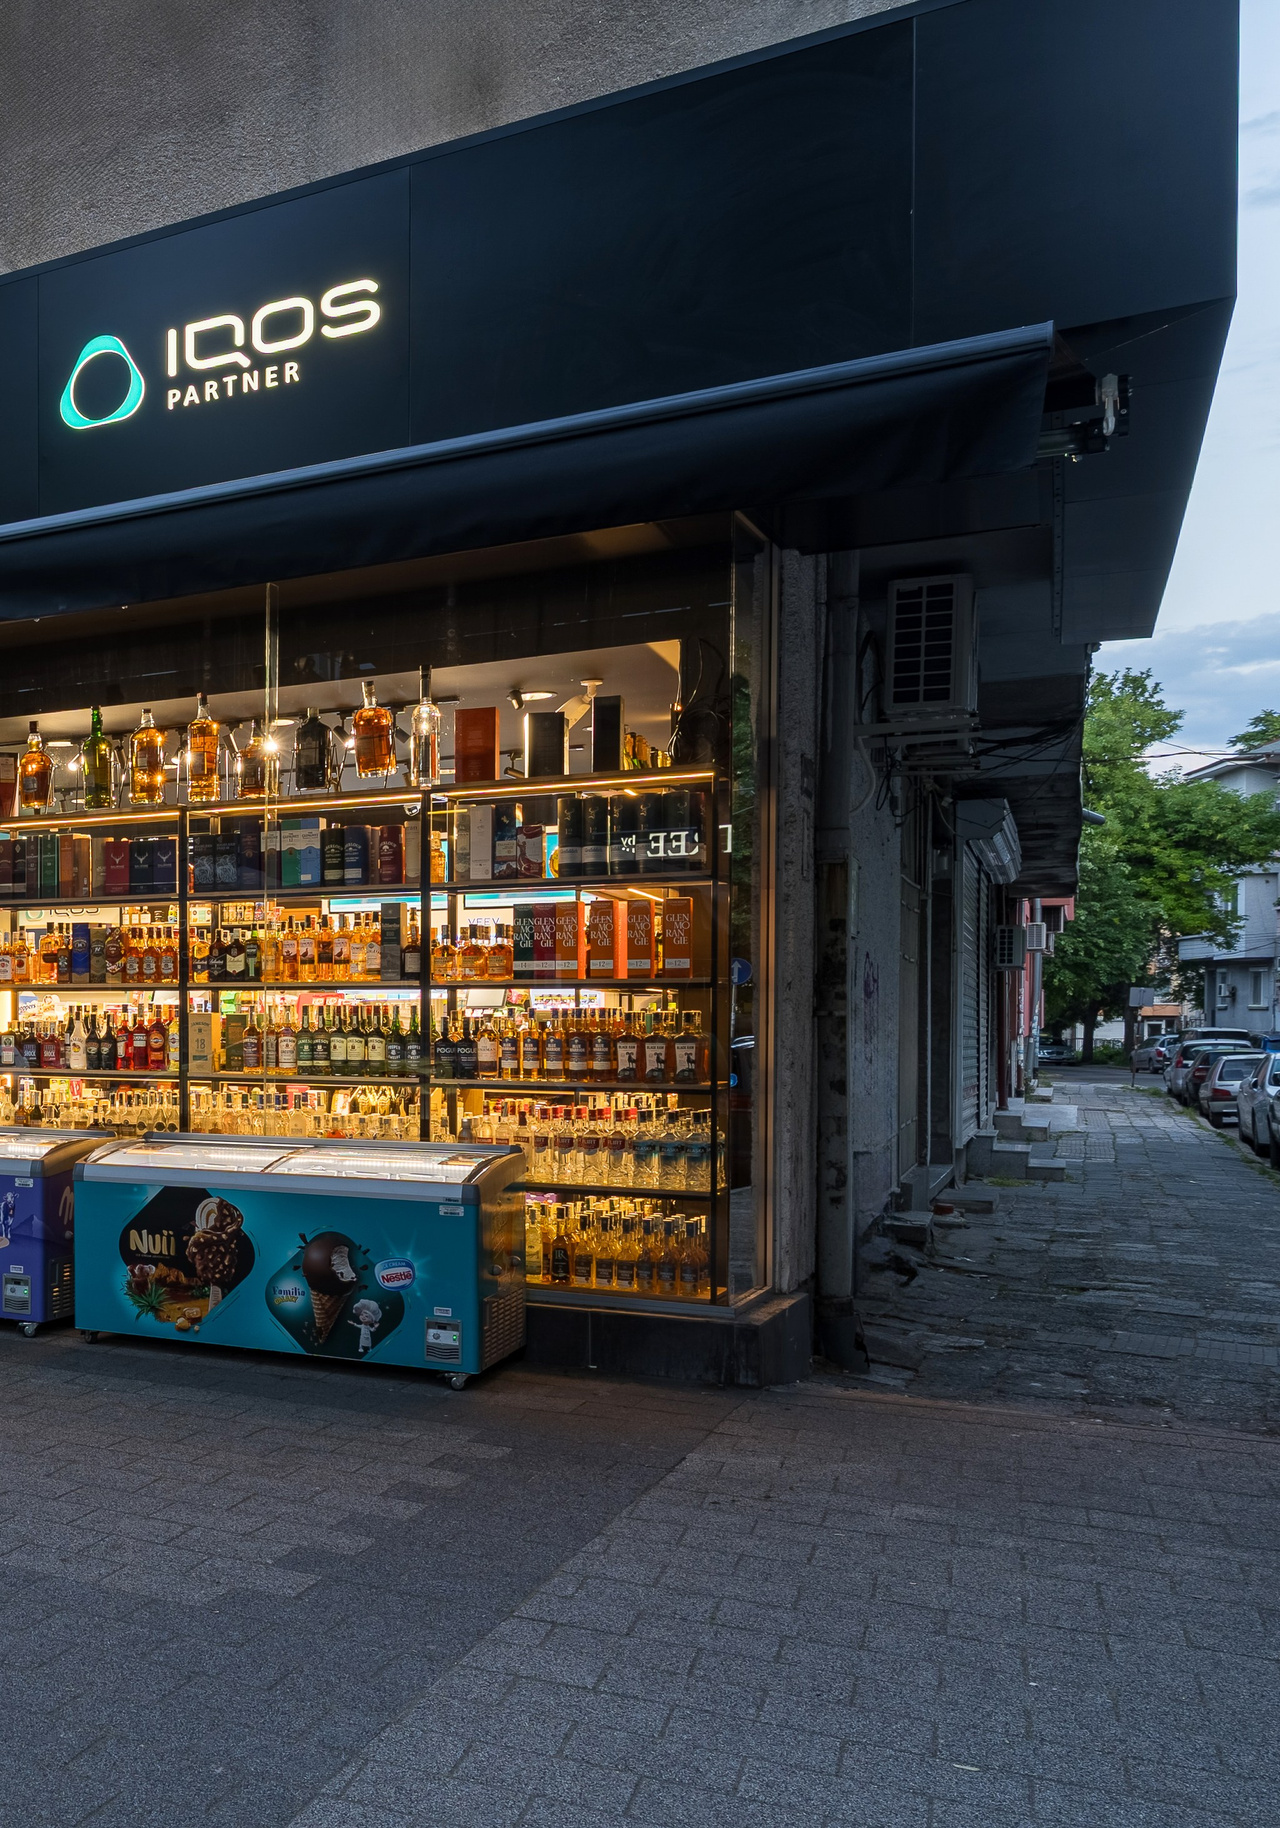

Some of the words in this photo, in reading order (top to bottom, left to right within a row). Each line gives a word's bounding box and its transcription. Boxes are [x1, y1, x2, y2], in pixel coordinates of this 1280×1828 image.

[167, 279, 381, 377] IQOS
[167, 361, 300, 410] PARTNER
[534, 917, 555, 926] GLEN
[556, 916, 578, 925] GLEN
[590, 915, 613, 924] GLEN
[627, 914, 650, 923] GLEN
[665, 913, 690, 922] GLEN
[514, 918, 534, 926] GLEN
[635, 922, 651, 930] MO
[674, 921, 691, 929] MO
[521, 925, 534, 933] MO
[542, 925, 556, 933] MO
[563, 924, 578, 932] MO
[598, 923, 613, 931] MO
[514, 932, 530, 941] RAN
[534, 932, 551, 940] RAN
[556, 931, 574, 940] RAN
[590, 931, 608, 939] RAN
[628, 930, 645, 938] RAN
[666, 929, 684, 937] RAN
[520, 940, 534, 948] GIE
[540, 940, 554, 948] GIE
[562, 939, 577, 947] GIE
[598, 938, 612, 946] GIE
[634, 937, 649, 945] GIE
[673, 937, 688, 945] GIE
[195, 1038, 206, 1049] 18
[129, 1228, 176, 1256] Nuii
[389, 1260, 406, 1268] CREAM
[272, 1285, 306, 1297] Familia
